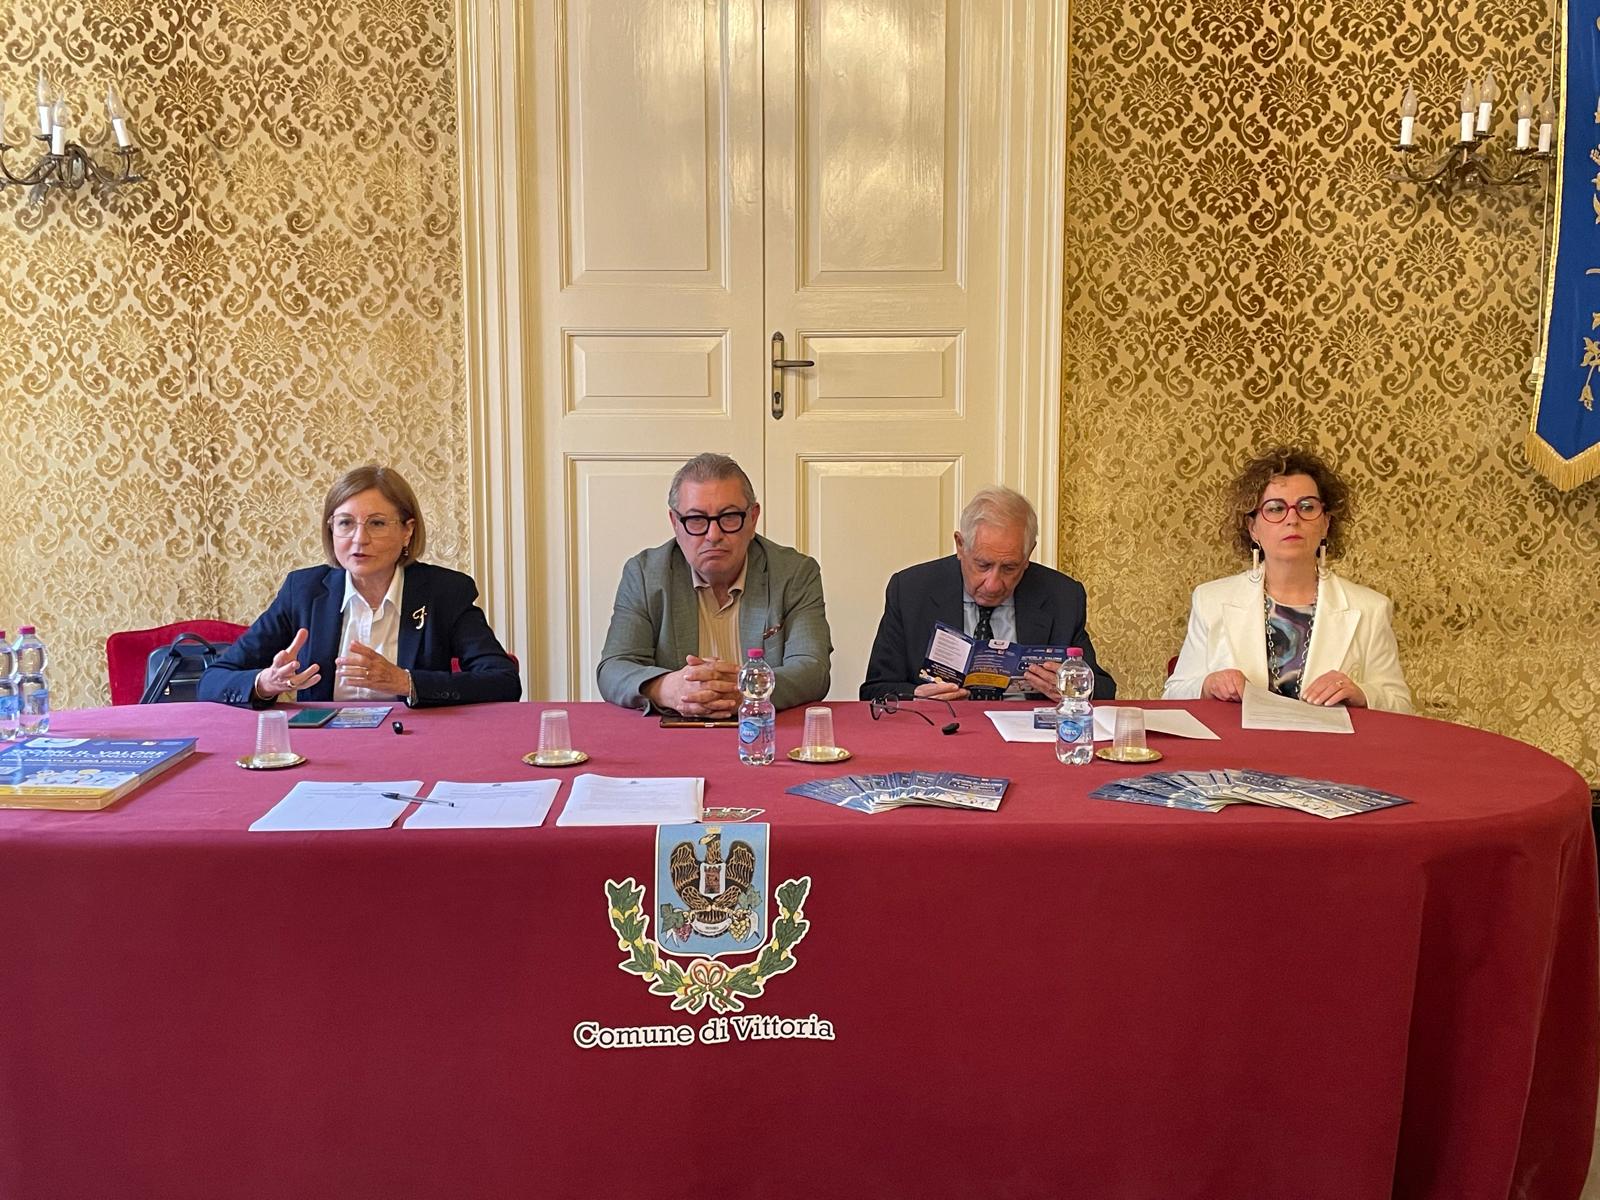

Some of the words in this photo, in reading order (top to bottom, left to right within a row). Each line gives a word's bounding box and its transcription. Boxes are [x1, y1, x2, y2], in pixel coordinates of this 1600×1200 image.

[575, 1023, 693, 1047] Comune
[701, 1018, 729, 1042] di
[734, 1015, 834, 1039] Vittoria
